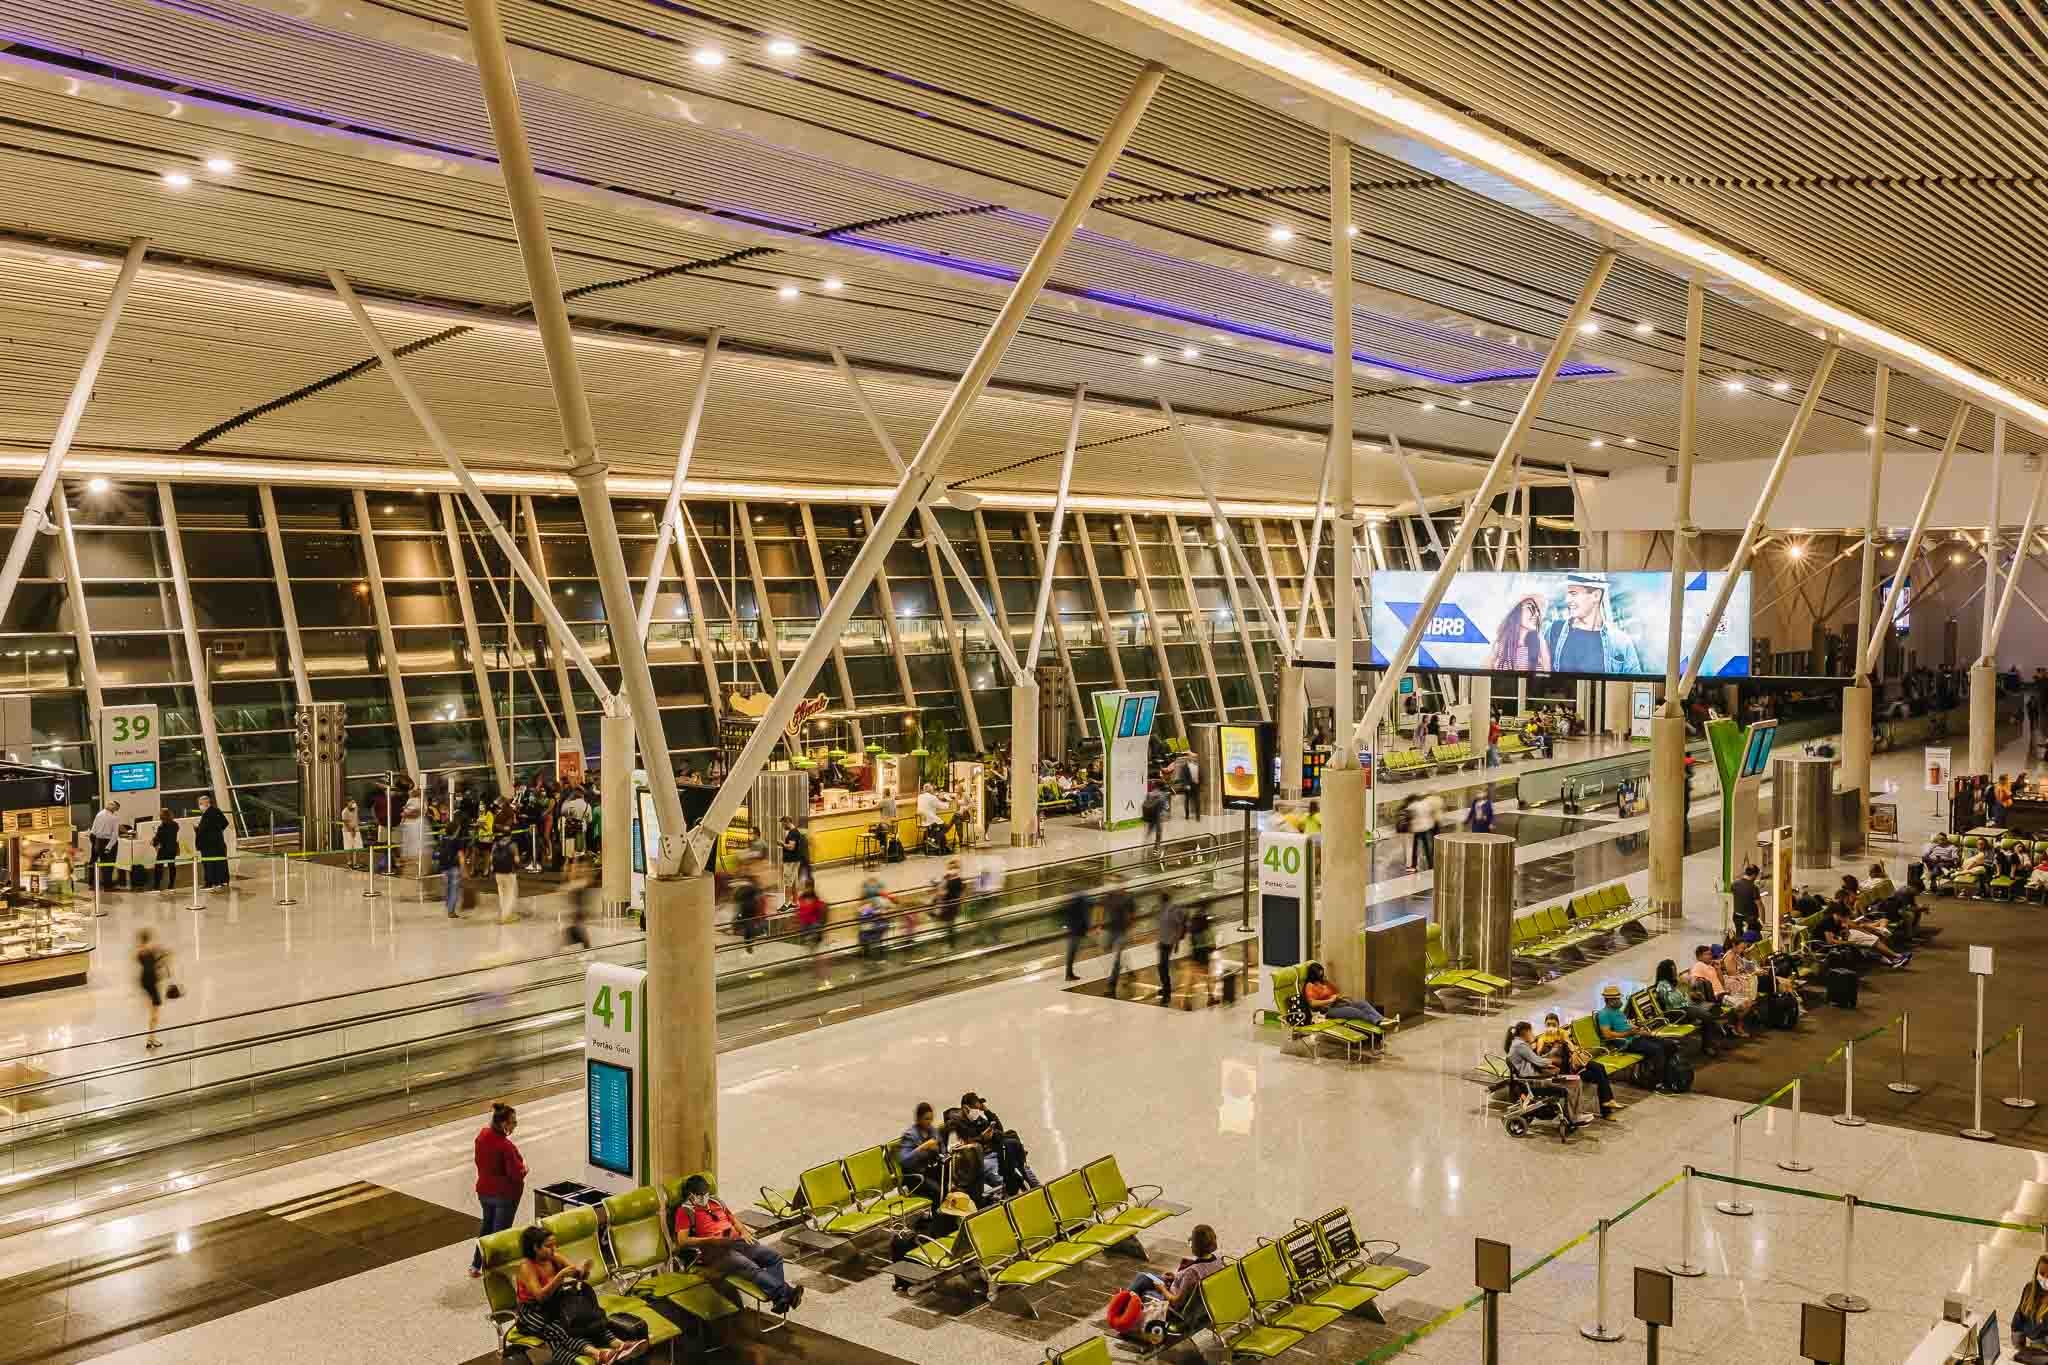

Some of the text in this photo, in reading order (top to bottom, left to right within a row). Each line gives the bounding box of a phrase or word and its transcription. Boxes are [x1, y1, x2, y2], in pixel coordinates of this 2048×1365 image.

[112, 715, 150, 741] 39
[1263, 845, 1301, 874] 40
[592, 985, 632, 1033] 41
[592, 1039, 614, 1051] Portão
